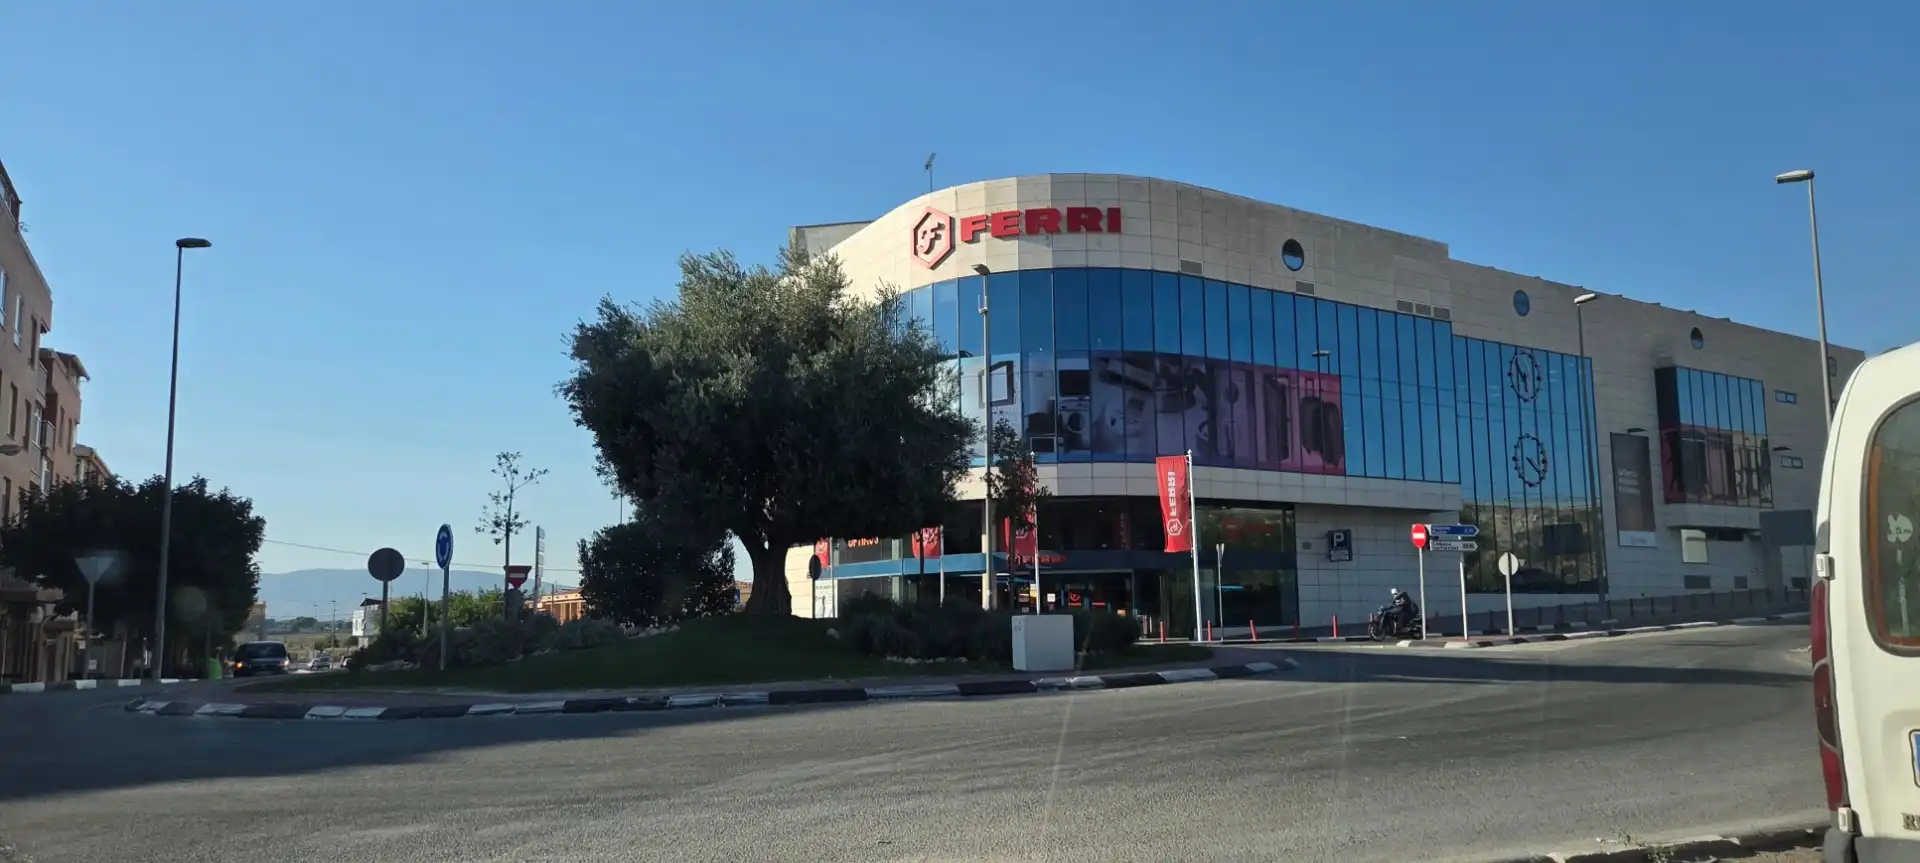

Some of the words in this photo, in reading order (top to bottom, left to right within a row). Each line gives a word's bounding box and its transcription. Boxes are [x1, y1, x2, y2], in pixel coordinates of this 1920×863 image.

[960, 206, 1122, 243] FERRI
[1167, 471, 1177, 517] FERRI
[1333, 532, 1345, 547] P
